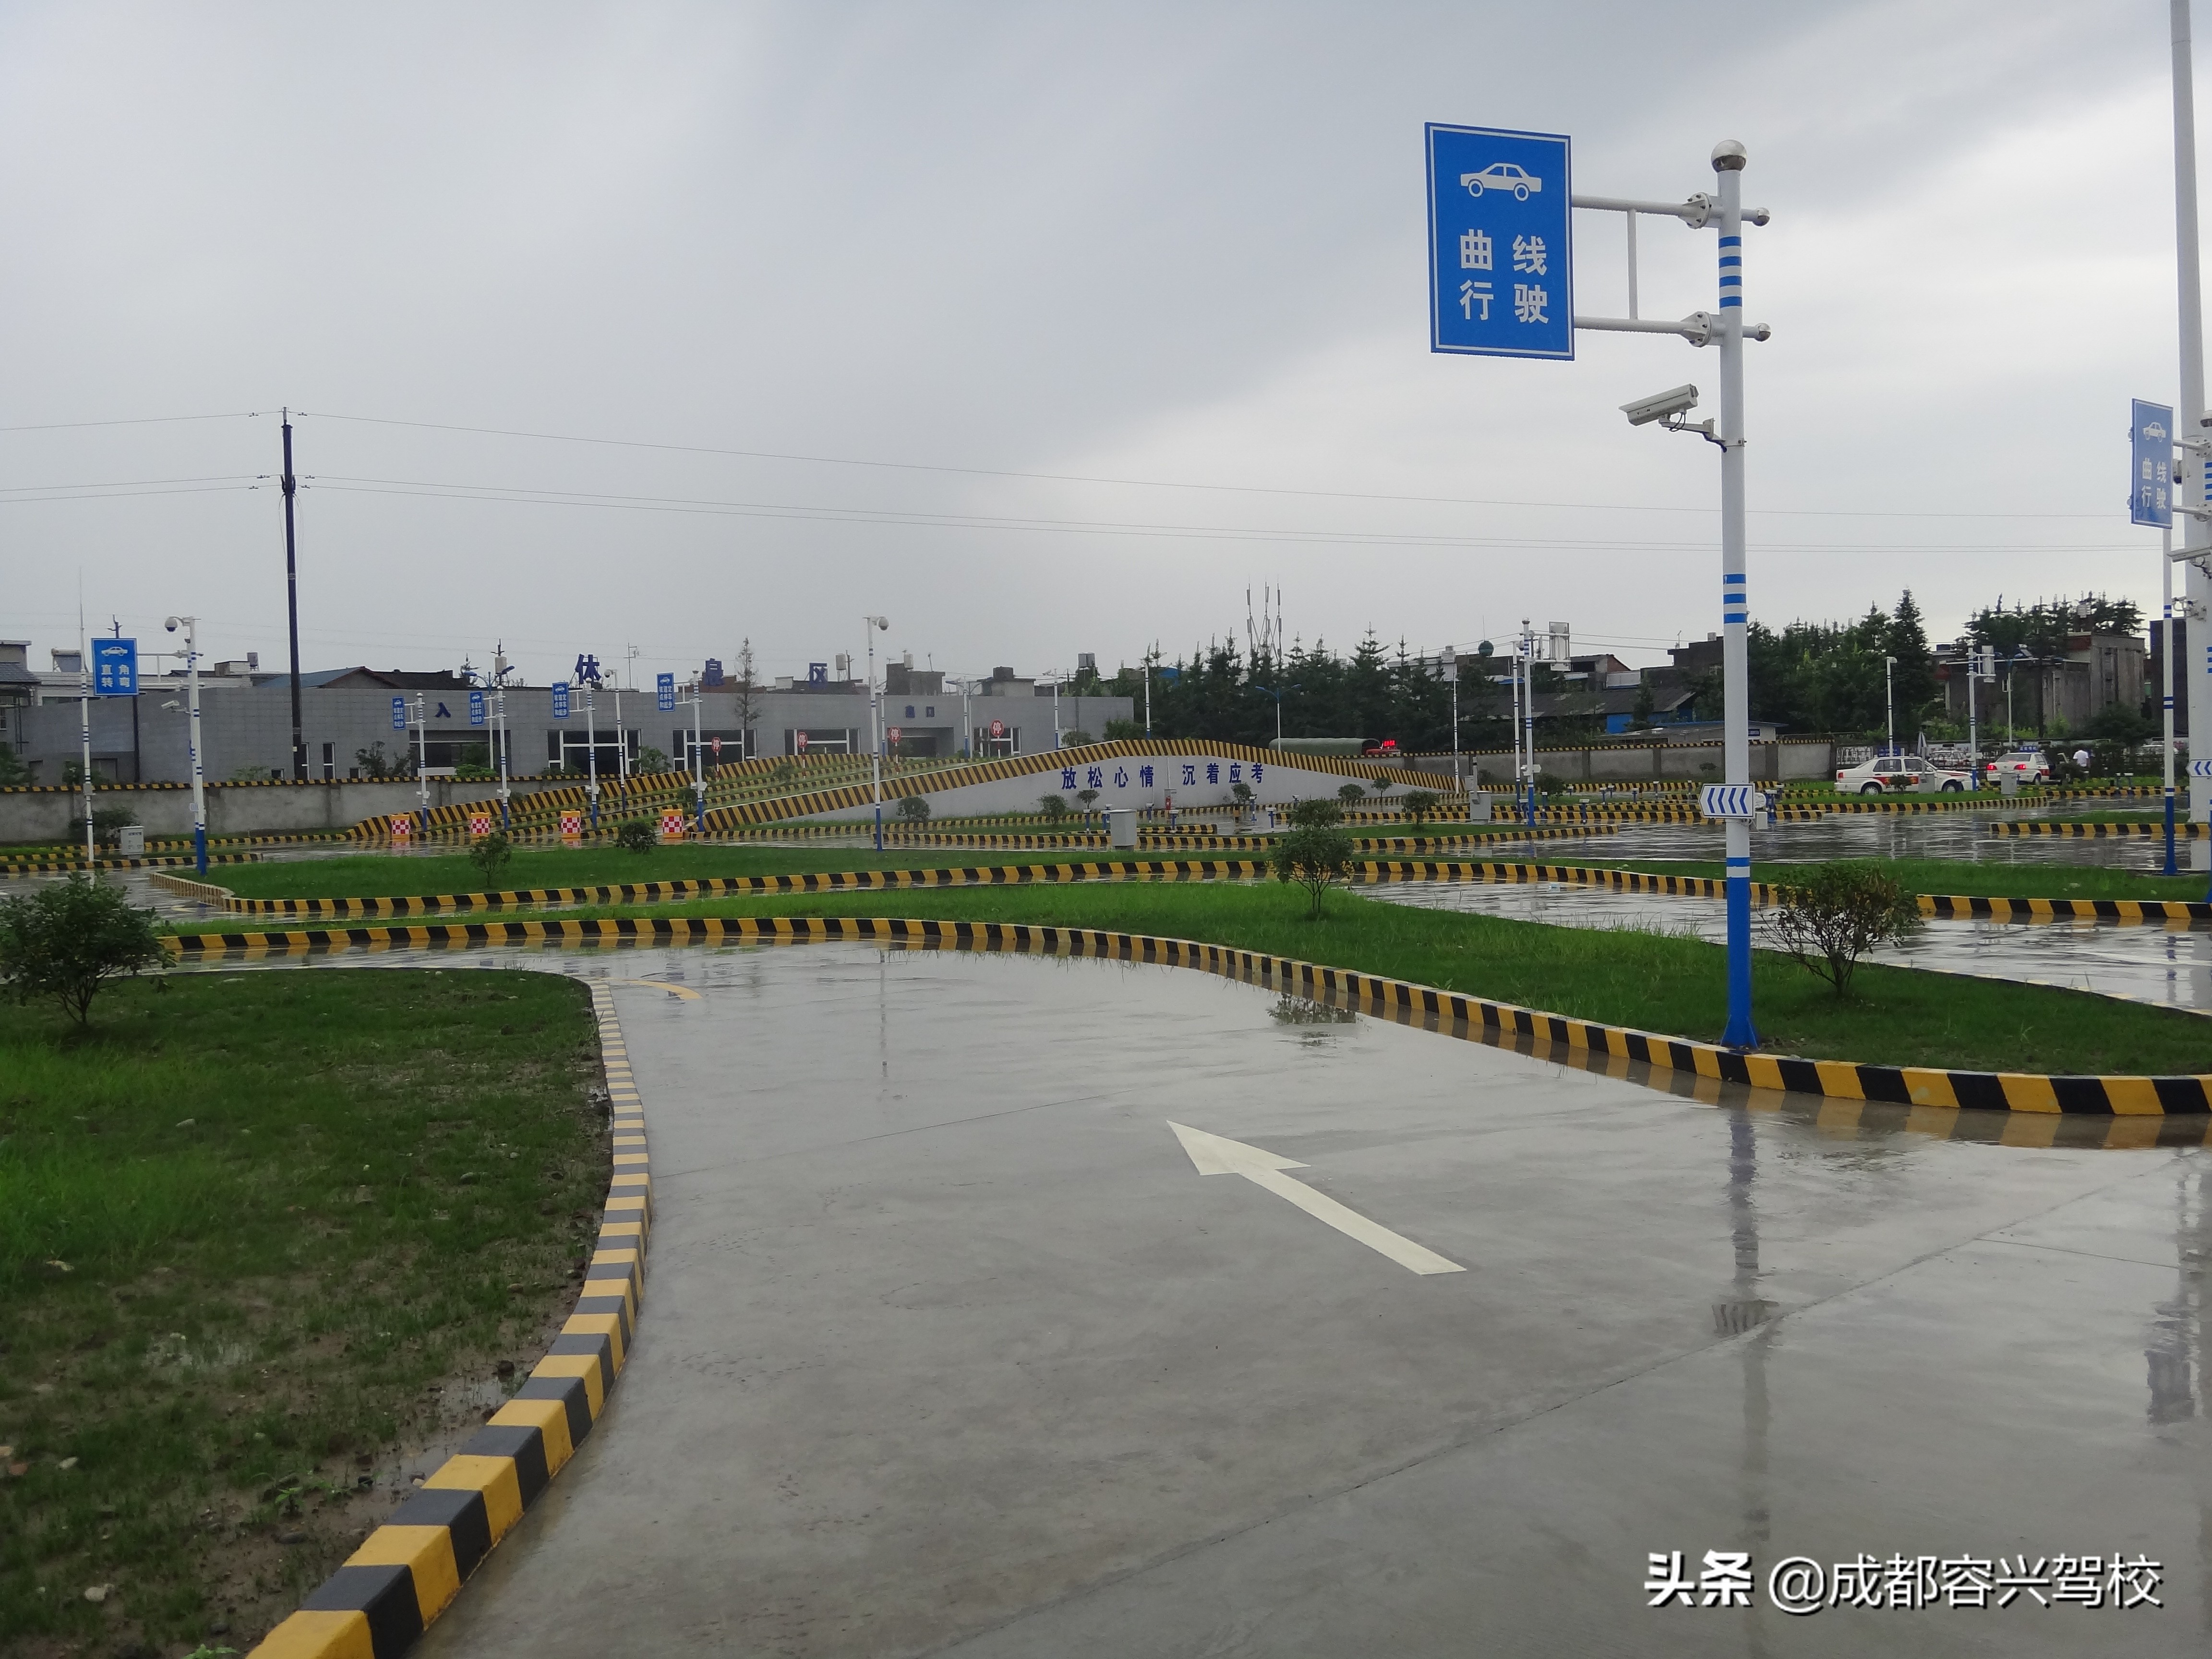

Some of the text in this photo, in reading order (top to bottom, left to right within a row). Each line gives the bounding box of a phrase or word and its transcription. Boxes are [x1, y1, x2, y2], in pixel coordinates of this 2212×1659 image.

[1459, 228, 1548, 276] 曲线
[1459, 279, 1549, 324] 行驶
[2142, 457, 2167, 483] 曲线
[2141, 484, 2166, 510] 行驶
[101, 664, 129, 675] 直角
[101, 677, 130, 687] 转弯
[891, 728, 899, 740] 停
[993, 721, 1002, 734] 停
[713, 739, 720, 750] 停
[799, 734, 806, 745] 停
[1061, 762, 1264, 790] 放松心情 沉着应考
